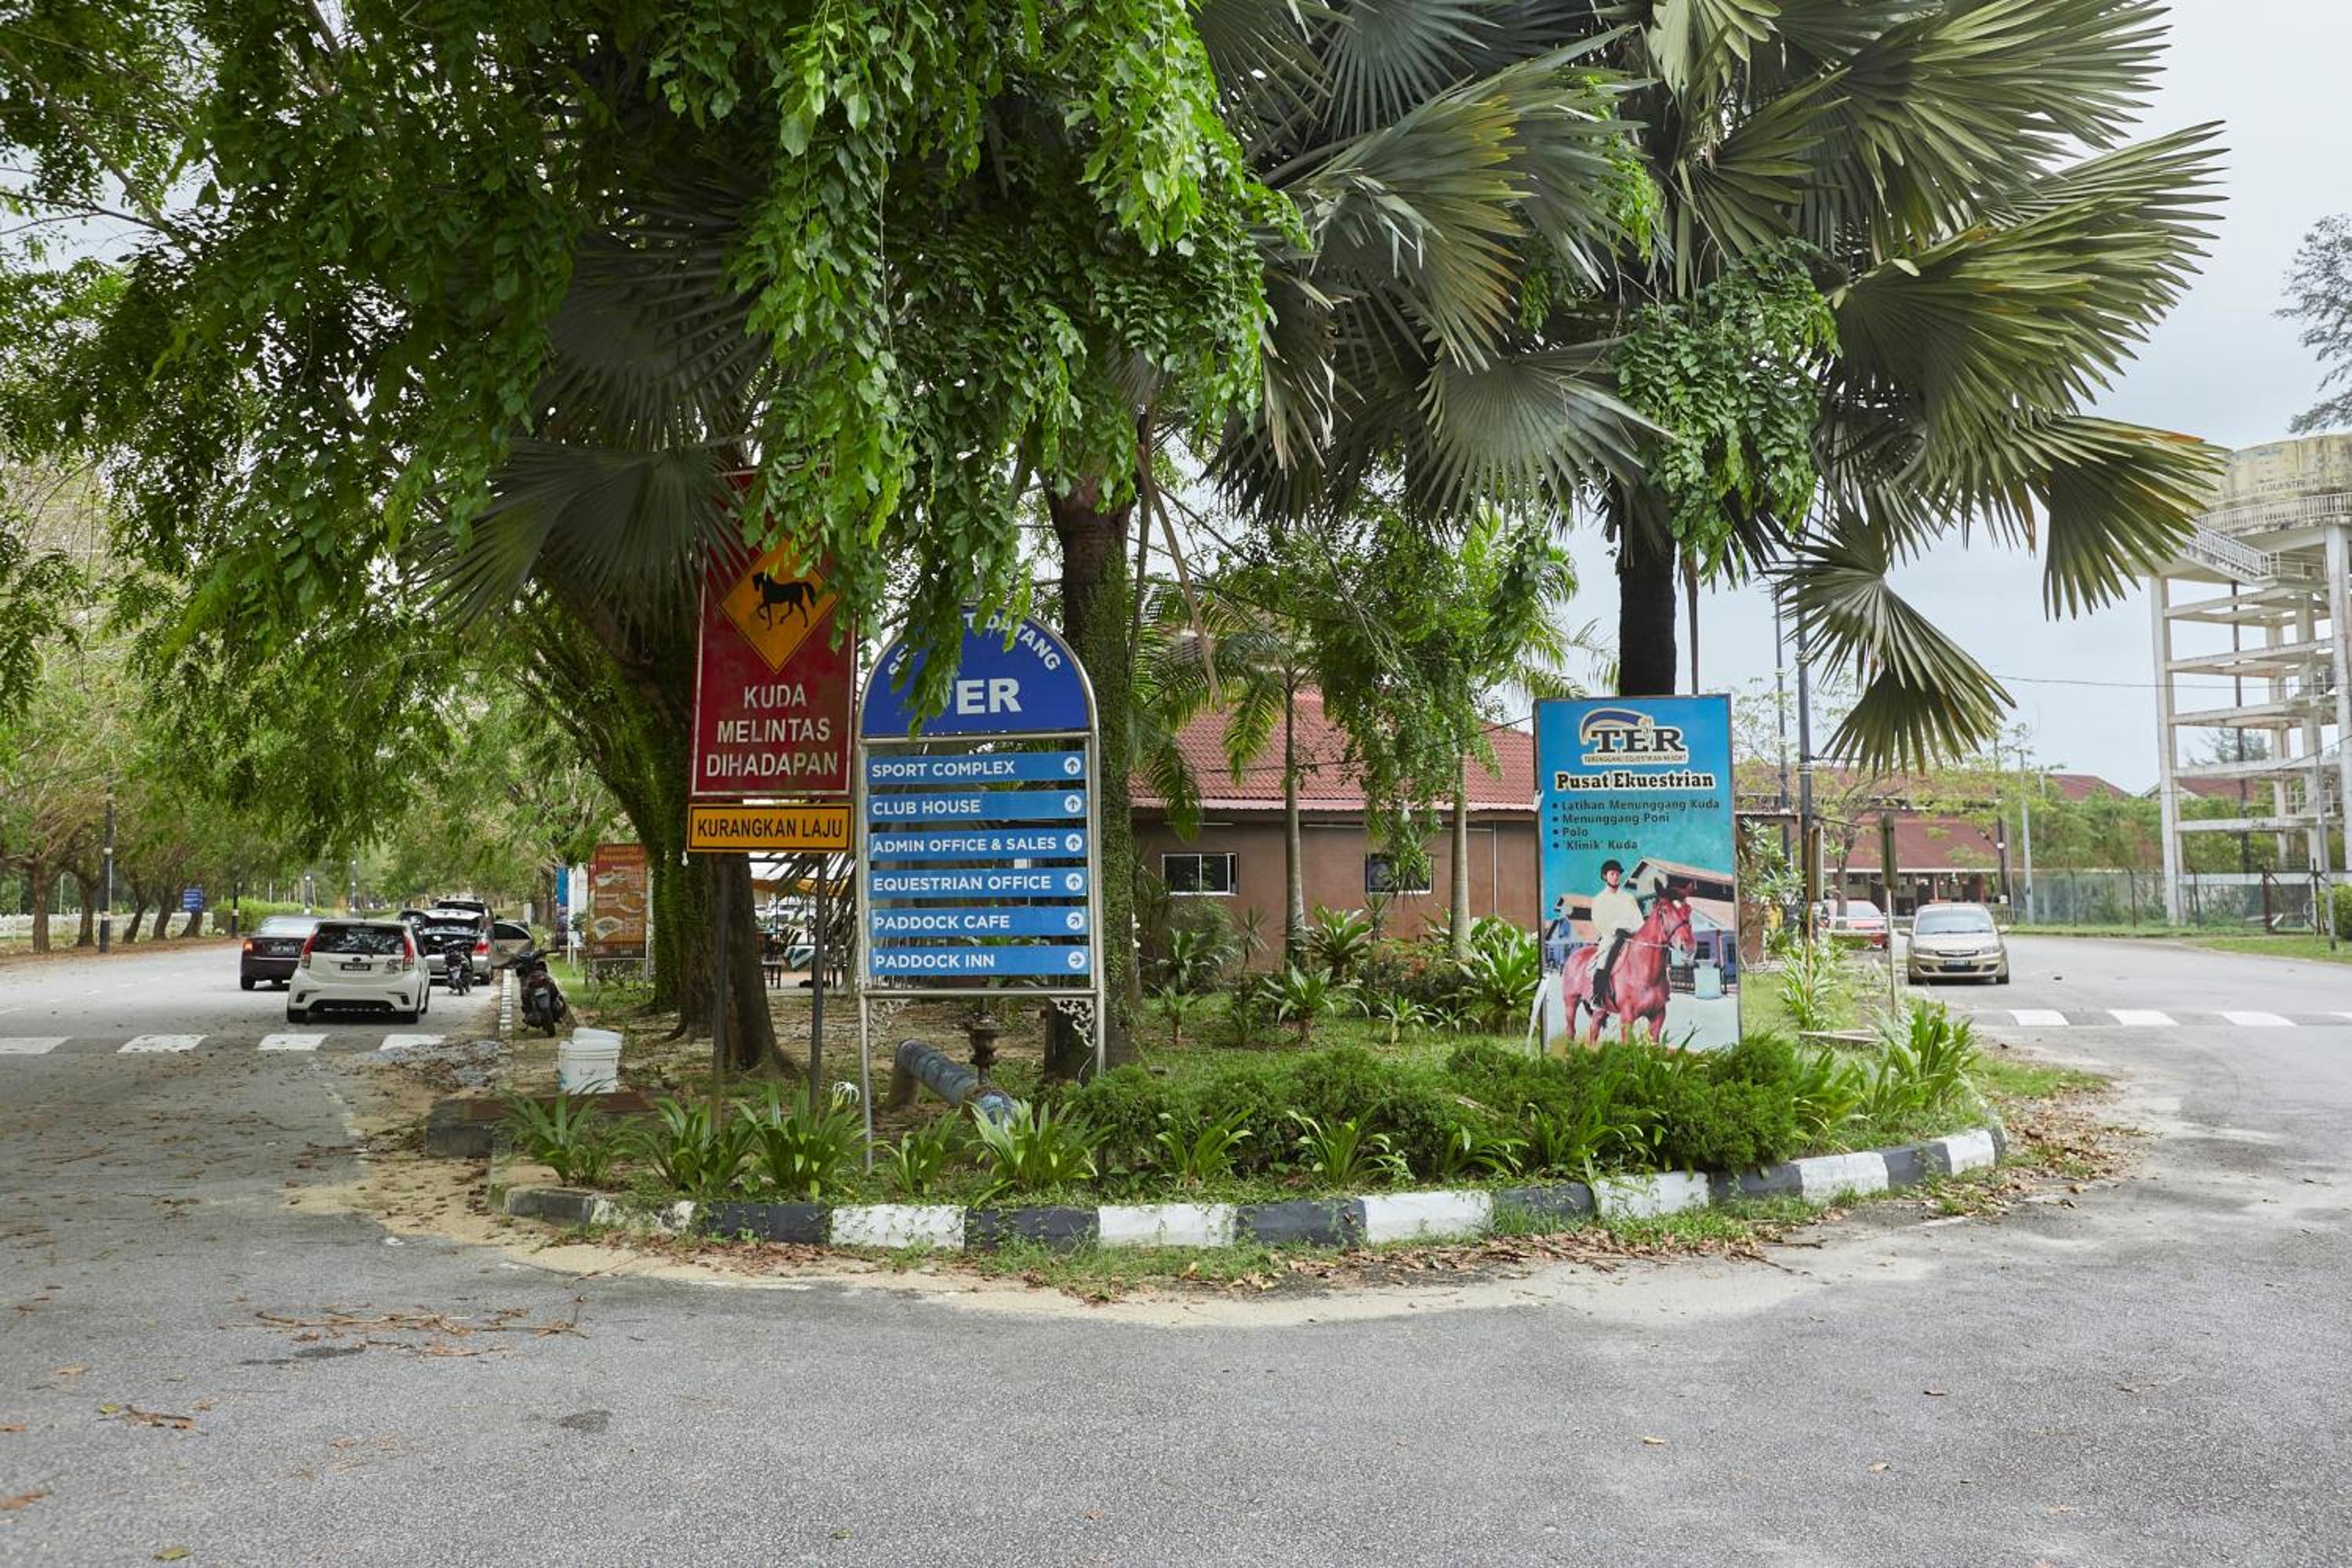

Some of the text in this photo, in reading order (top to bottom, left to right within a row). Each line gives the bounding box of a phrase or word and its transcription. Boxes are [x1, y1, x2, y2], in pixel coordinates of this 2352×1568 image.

[744, 683, 806, 709] KUDA
[956, 678, 1022, 715] ER
[717, 717, 831, 743] MELINTAS
[1591, 728, 1686, 753] TER
[706, 751, 838, 777] DIHADAPAN
[872, 760, 1015, 778] SPORT COMPLEX
[1555, 771, 1714, 789] Pusat Ekuestrian
[872, 800, 981, 815] CLUB HOUSE
[1563, 798, 1719, 811] Latihan Menunggang Kuda
[1563, 811, 1669, 826] Menunggang Poni
[697, 818, 843, 838] KURANGKAN LAJU
[1563, 827, 1588, 837] Polo
[873, 837, 1056, 853] ADMIN OFFICE & SALES
[1608, 840, 1638, 850] Kuda
[873, 876, 1051, 892] EQUESTRIAN OFFICE
[874, 914, 1010, 929] PADDOCK CAFE
[875, 953, 995, 968] PADDOCK INN
